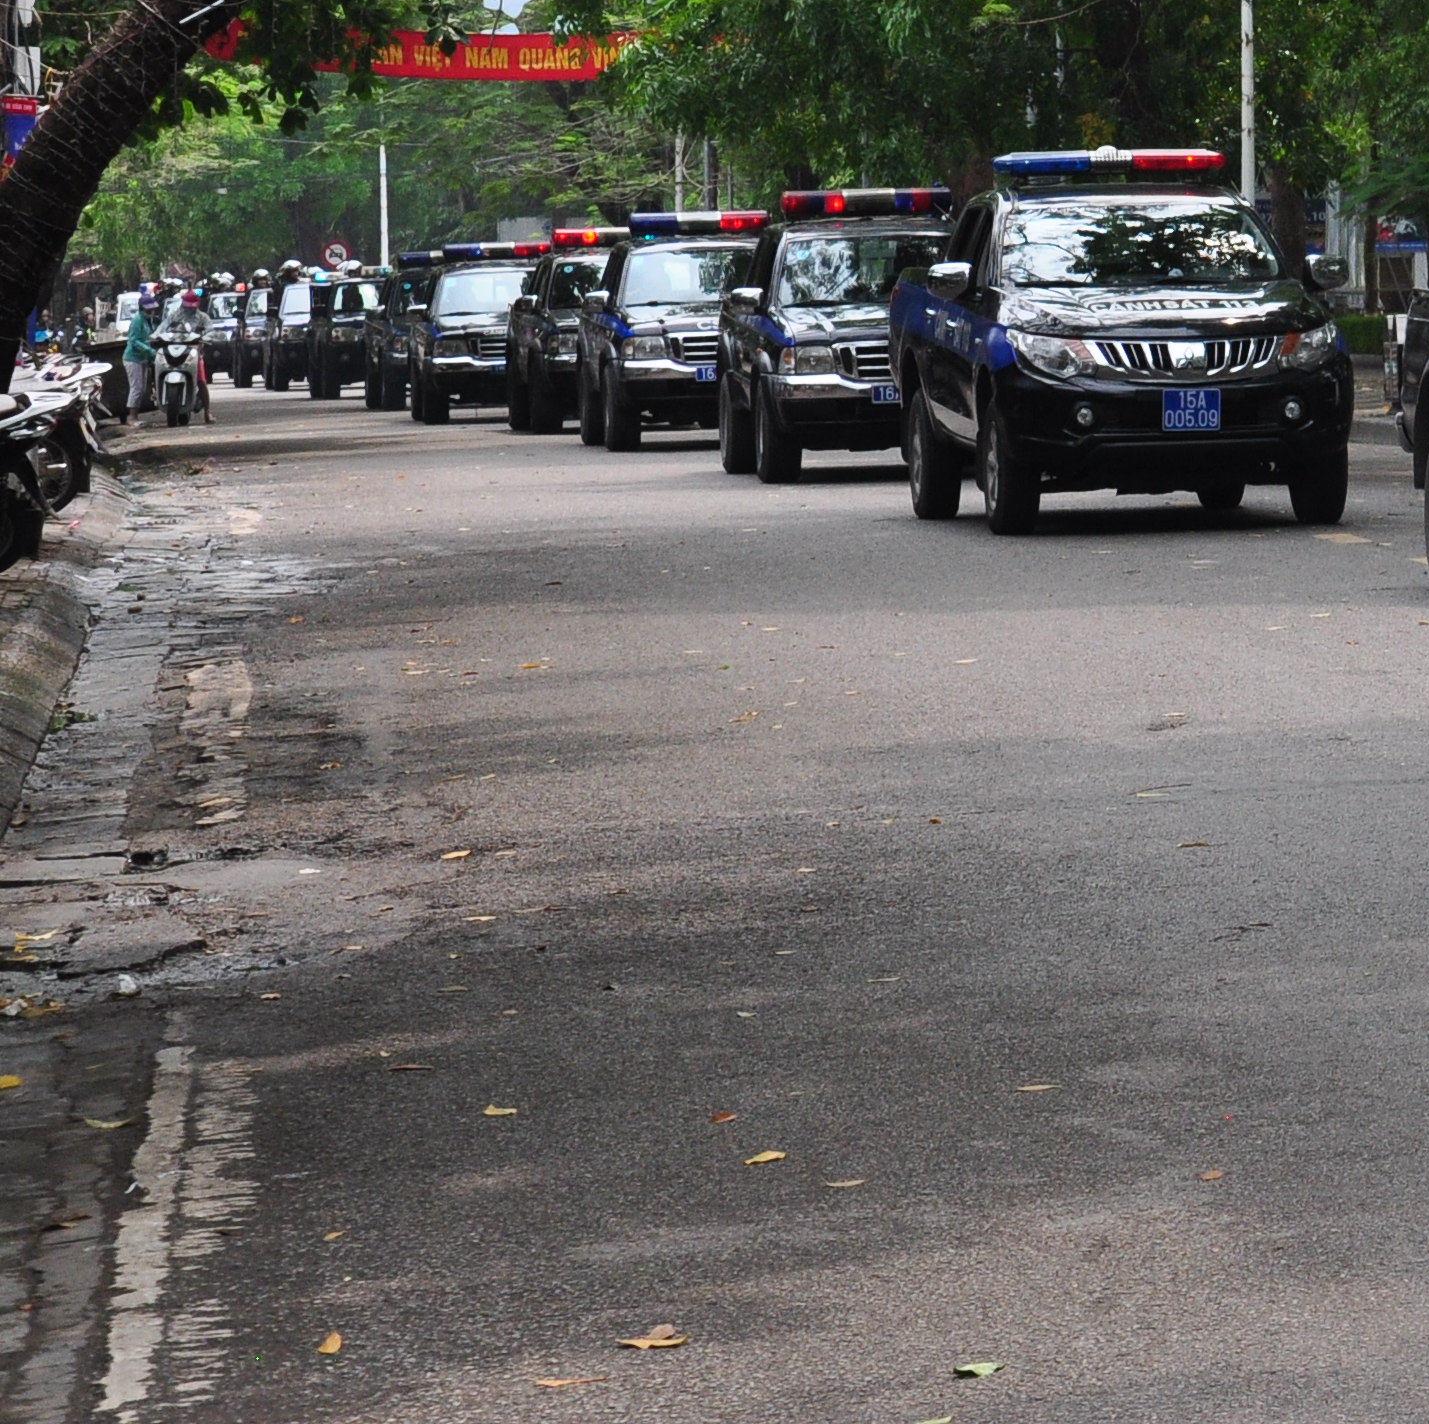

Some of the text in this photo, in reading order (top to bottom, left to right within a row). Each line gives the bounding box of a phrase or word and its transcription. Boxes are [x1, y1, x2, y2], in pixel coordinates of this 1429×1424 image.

[465, 46, 508, 70] NAM
[1178, 391, 1206, 407] 15A
[1164, 409, 1219, 428] 005.09
